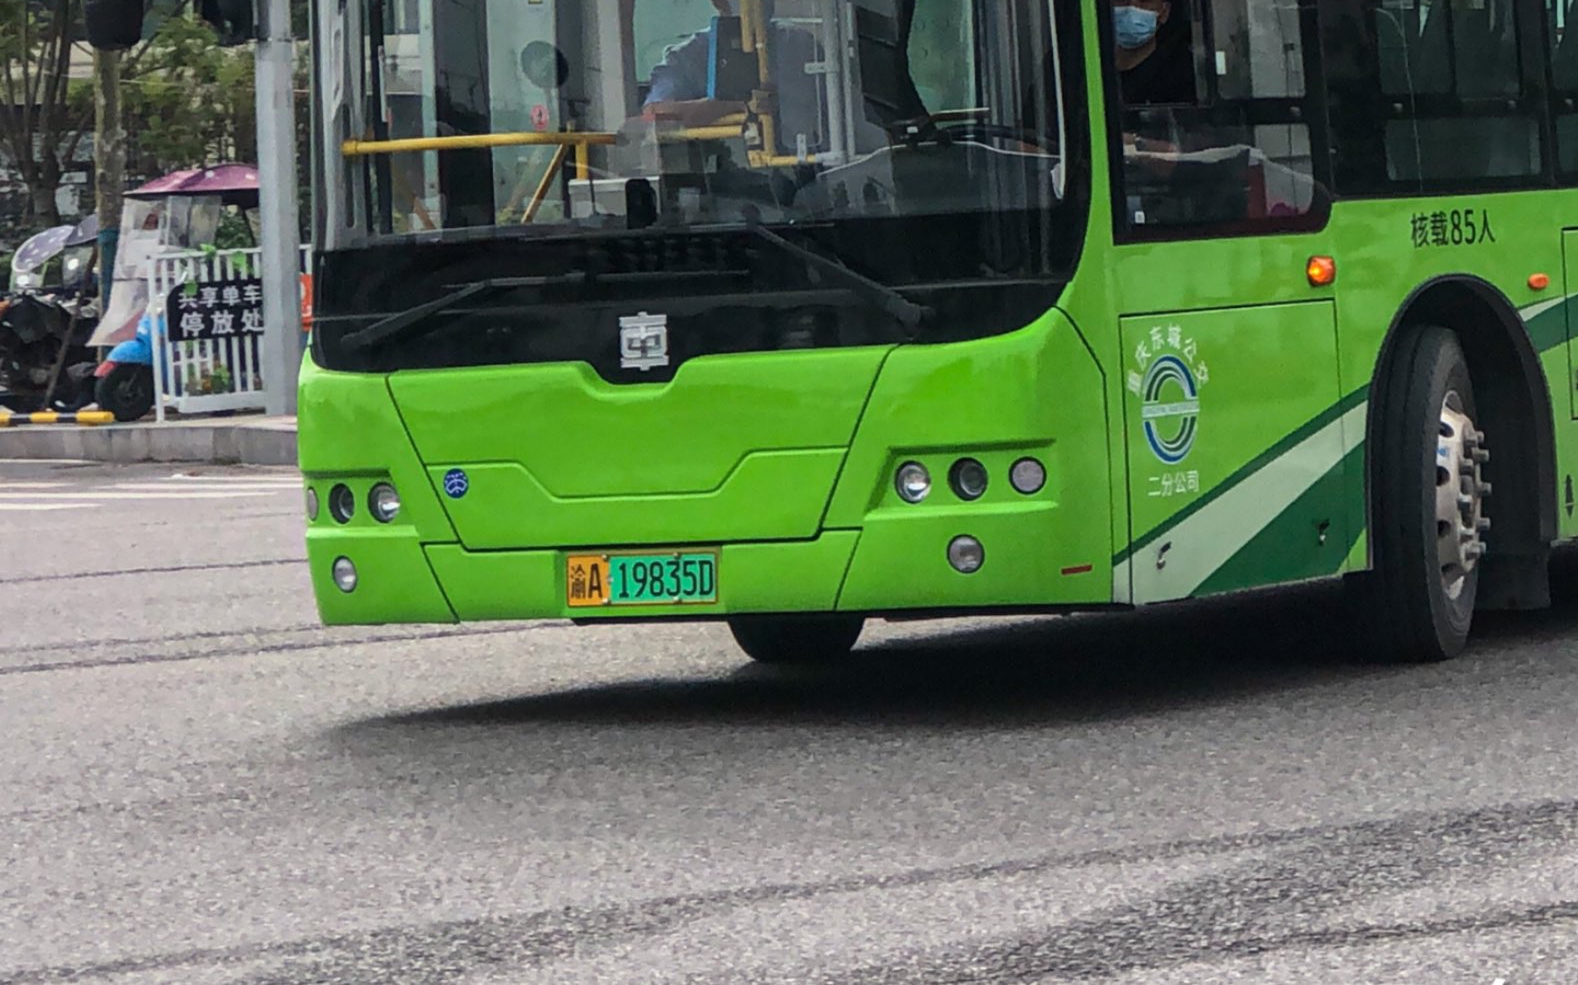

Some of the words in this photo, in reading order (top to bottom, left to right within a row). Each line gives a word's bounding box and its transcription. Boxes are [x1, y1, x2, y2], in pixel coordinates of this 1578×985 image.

[1410, 209, 1496, 248] 核载85人
[178, 284, 263, 309] 共享单车
[180, 308, 265, 337] 停放处
[1148, 470, 1200, 496] 二分公司
